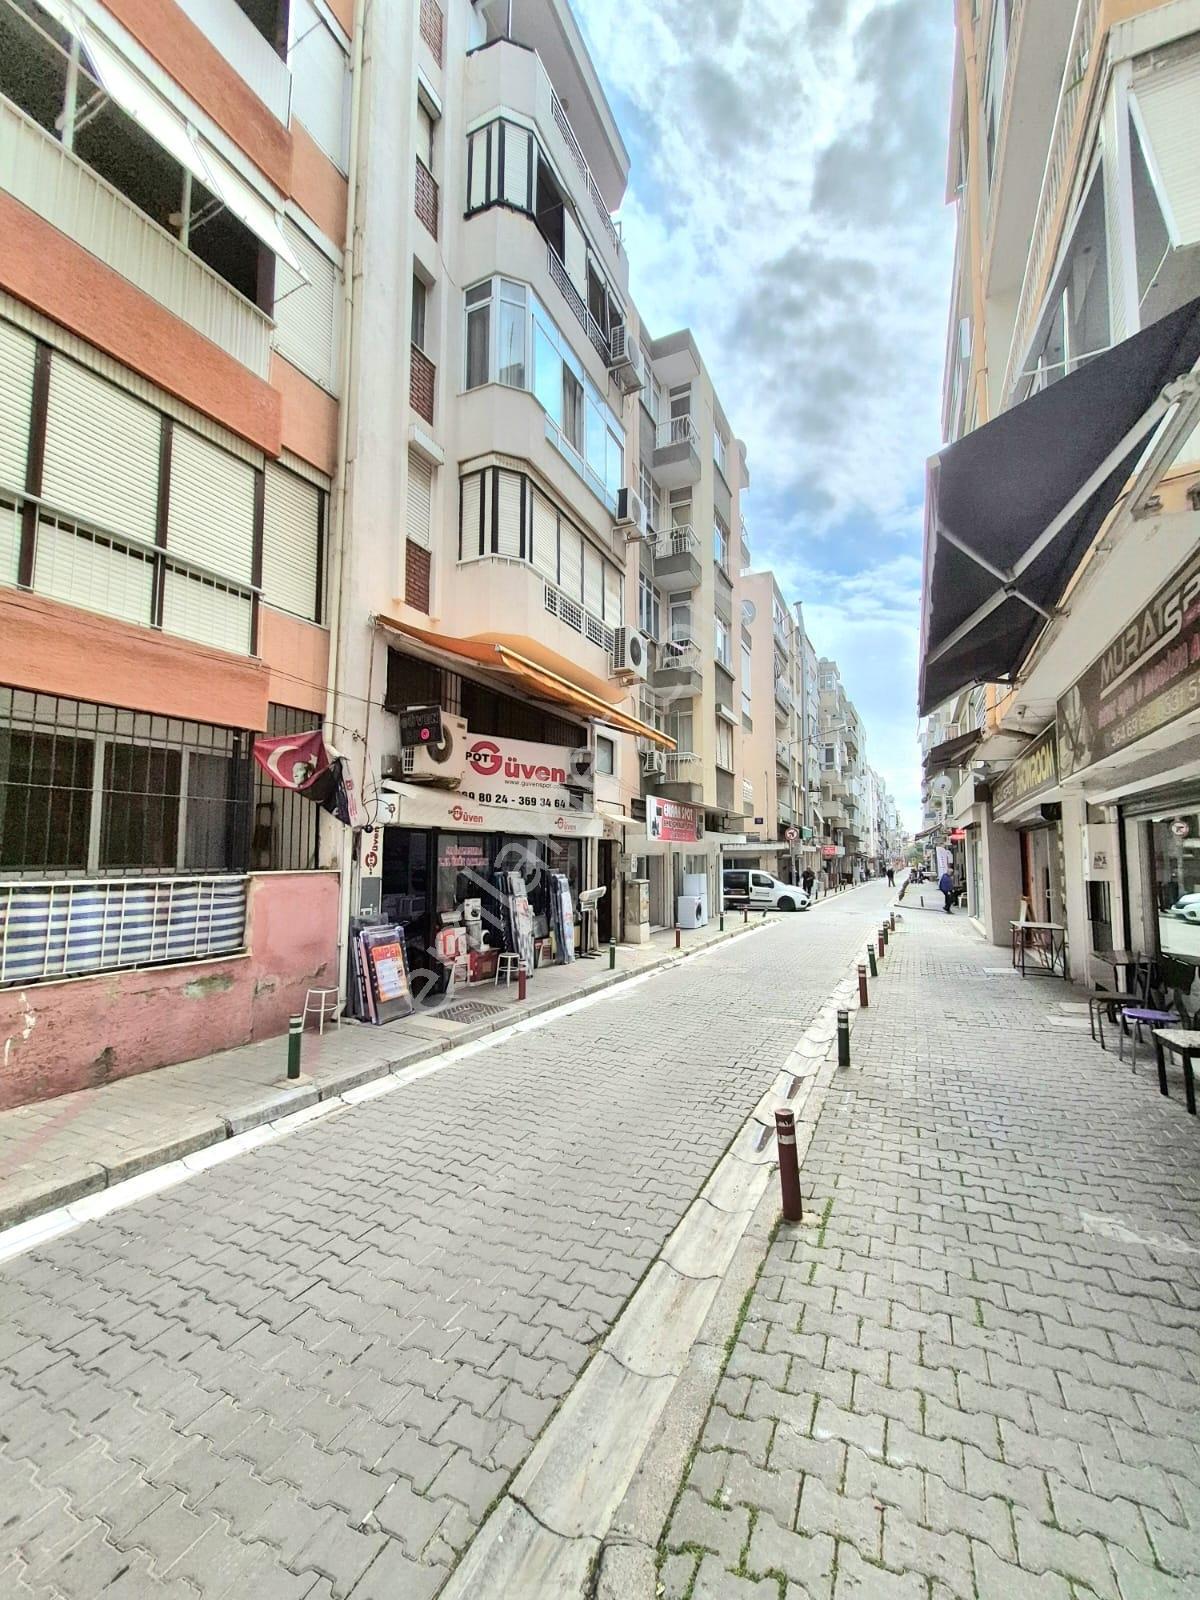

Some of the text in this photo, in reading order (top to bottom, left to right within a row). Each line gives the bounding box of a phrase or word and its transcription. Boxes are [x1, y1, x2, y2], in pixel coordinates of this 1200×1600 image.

[1100, 592, 1168, 690] MURAT
[465, 741, 566, 783] POT Güven
[452, 805, 483, 823] Güven
[479, 792, 492, 803] 80
[495, 794, 508, 804] 24
[518, 796, 537, 806] 369
[554, 799, 566, 809] 64
